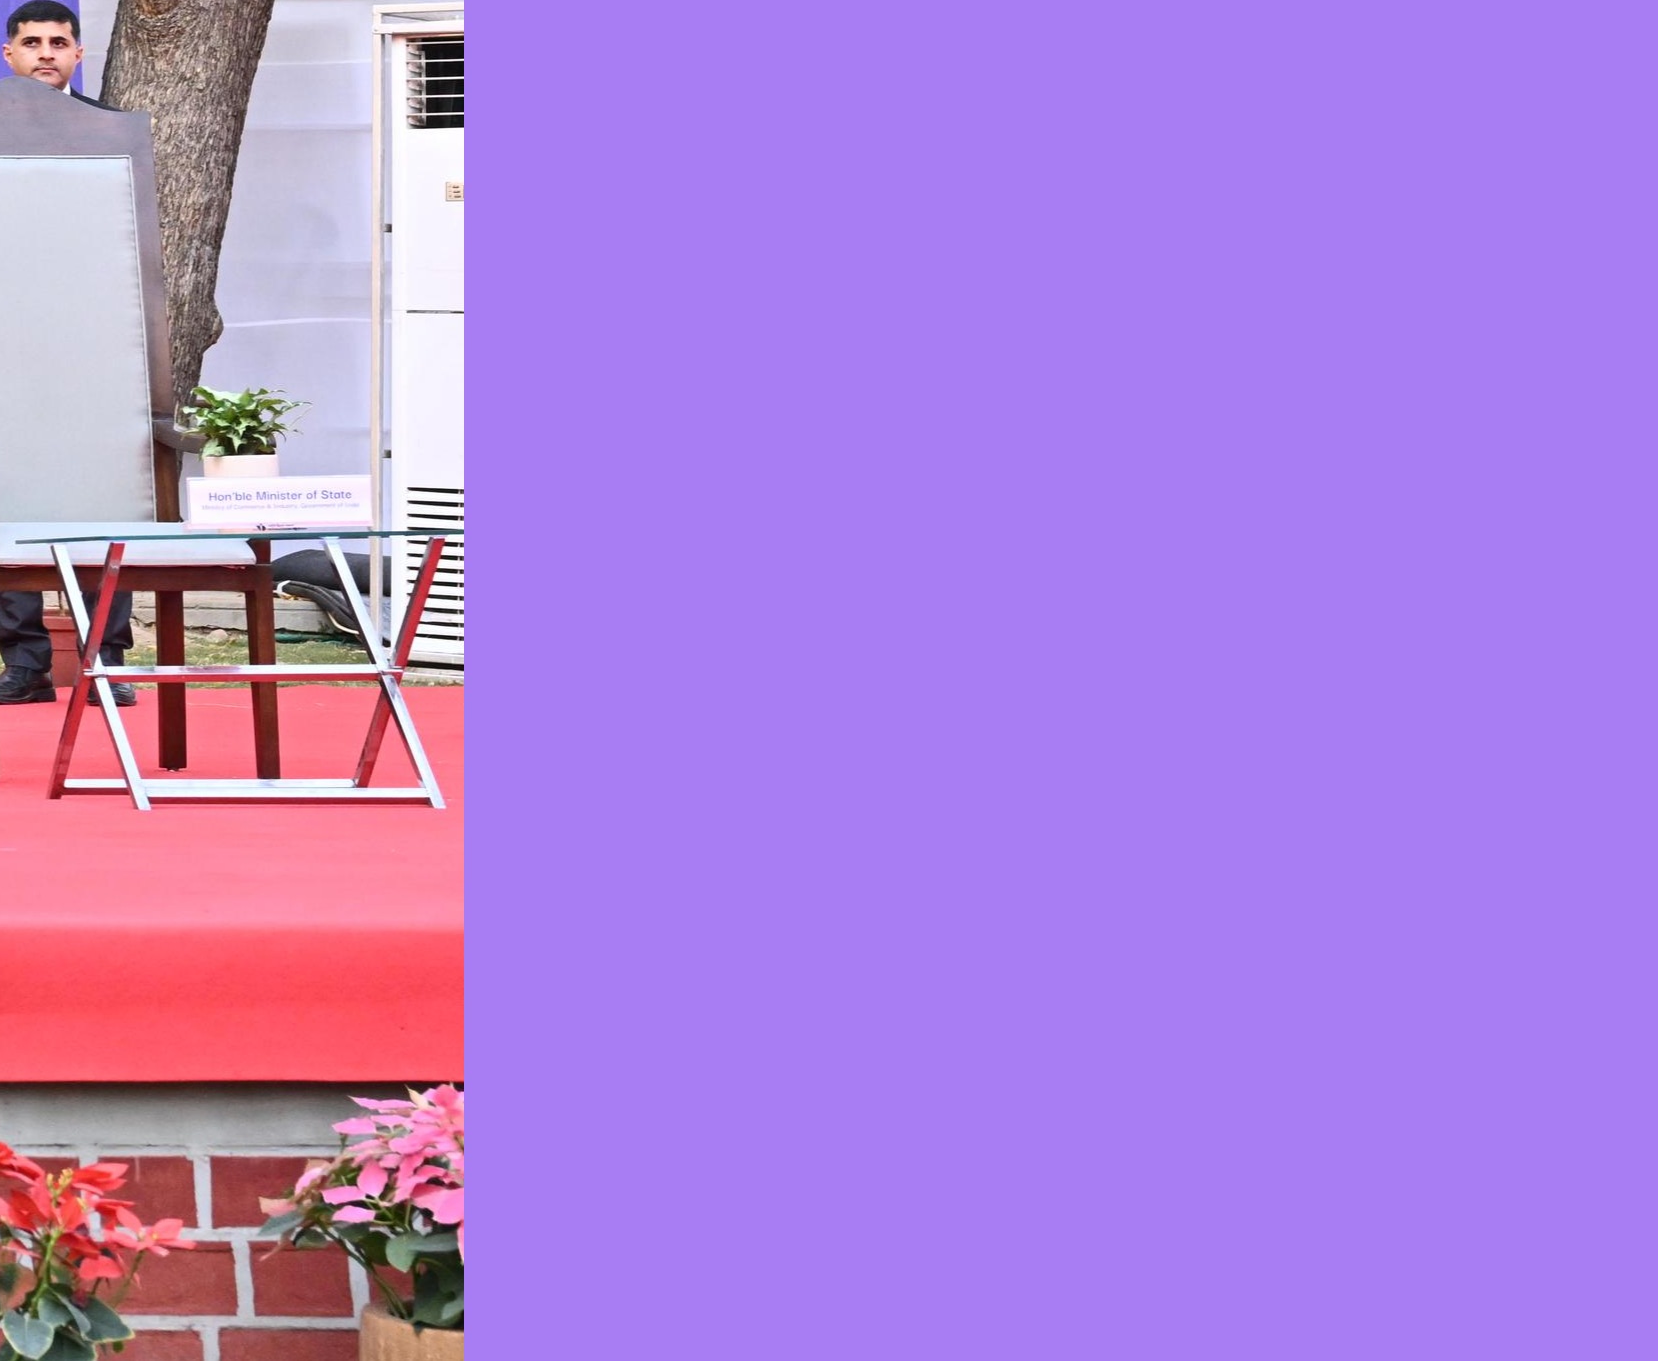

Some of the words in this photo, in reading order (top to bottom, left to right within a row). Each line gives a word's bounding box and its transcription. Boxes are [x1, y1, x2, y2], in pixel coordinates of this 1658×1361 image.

[256, 490, 302, 501] Minister
[306, 490, 318, 500] of
[321, 489, 352, 500] State
